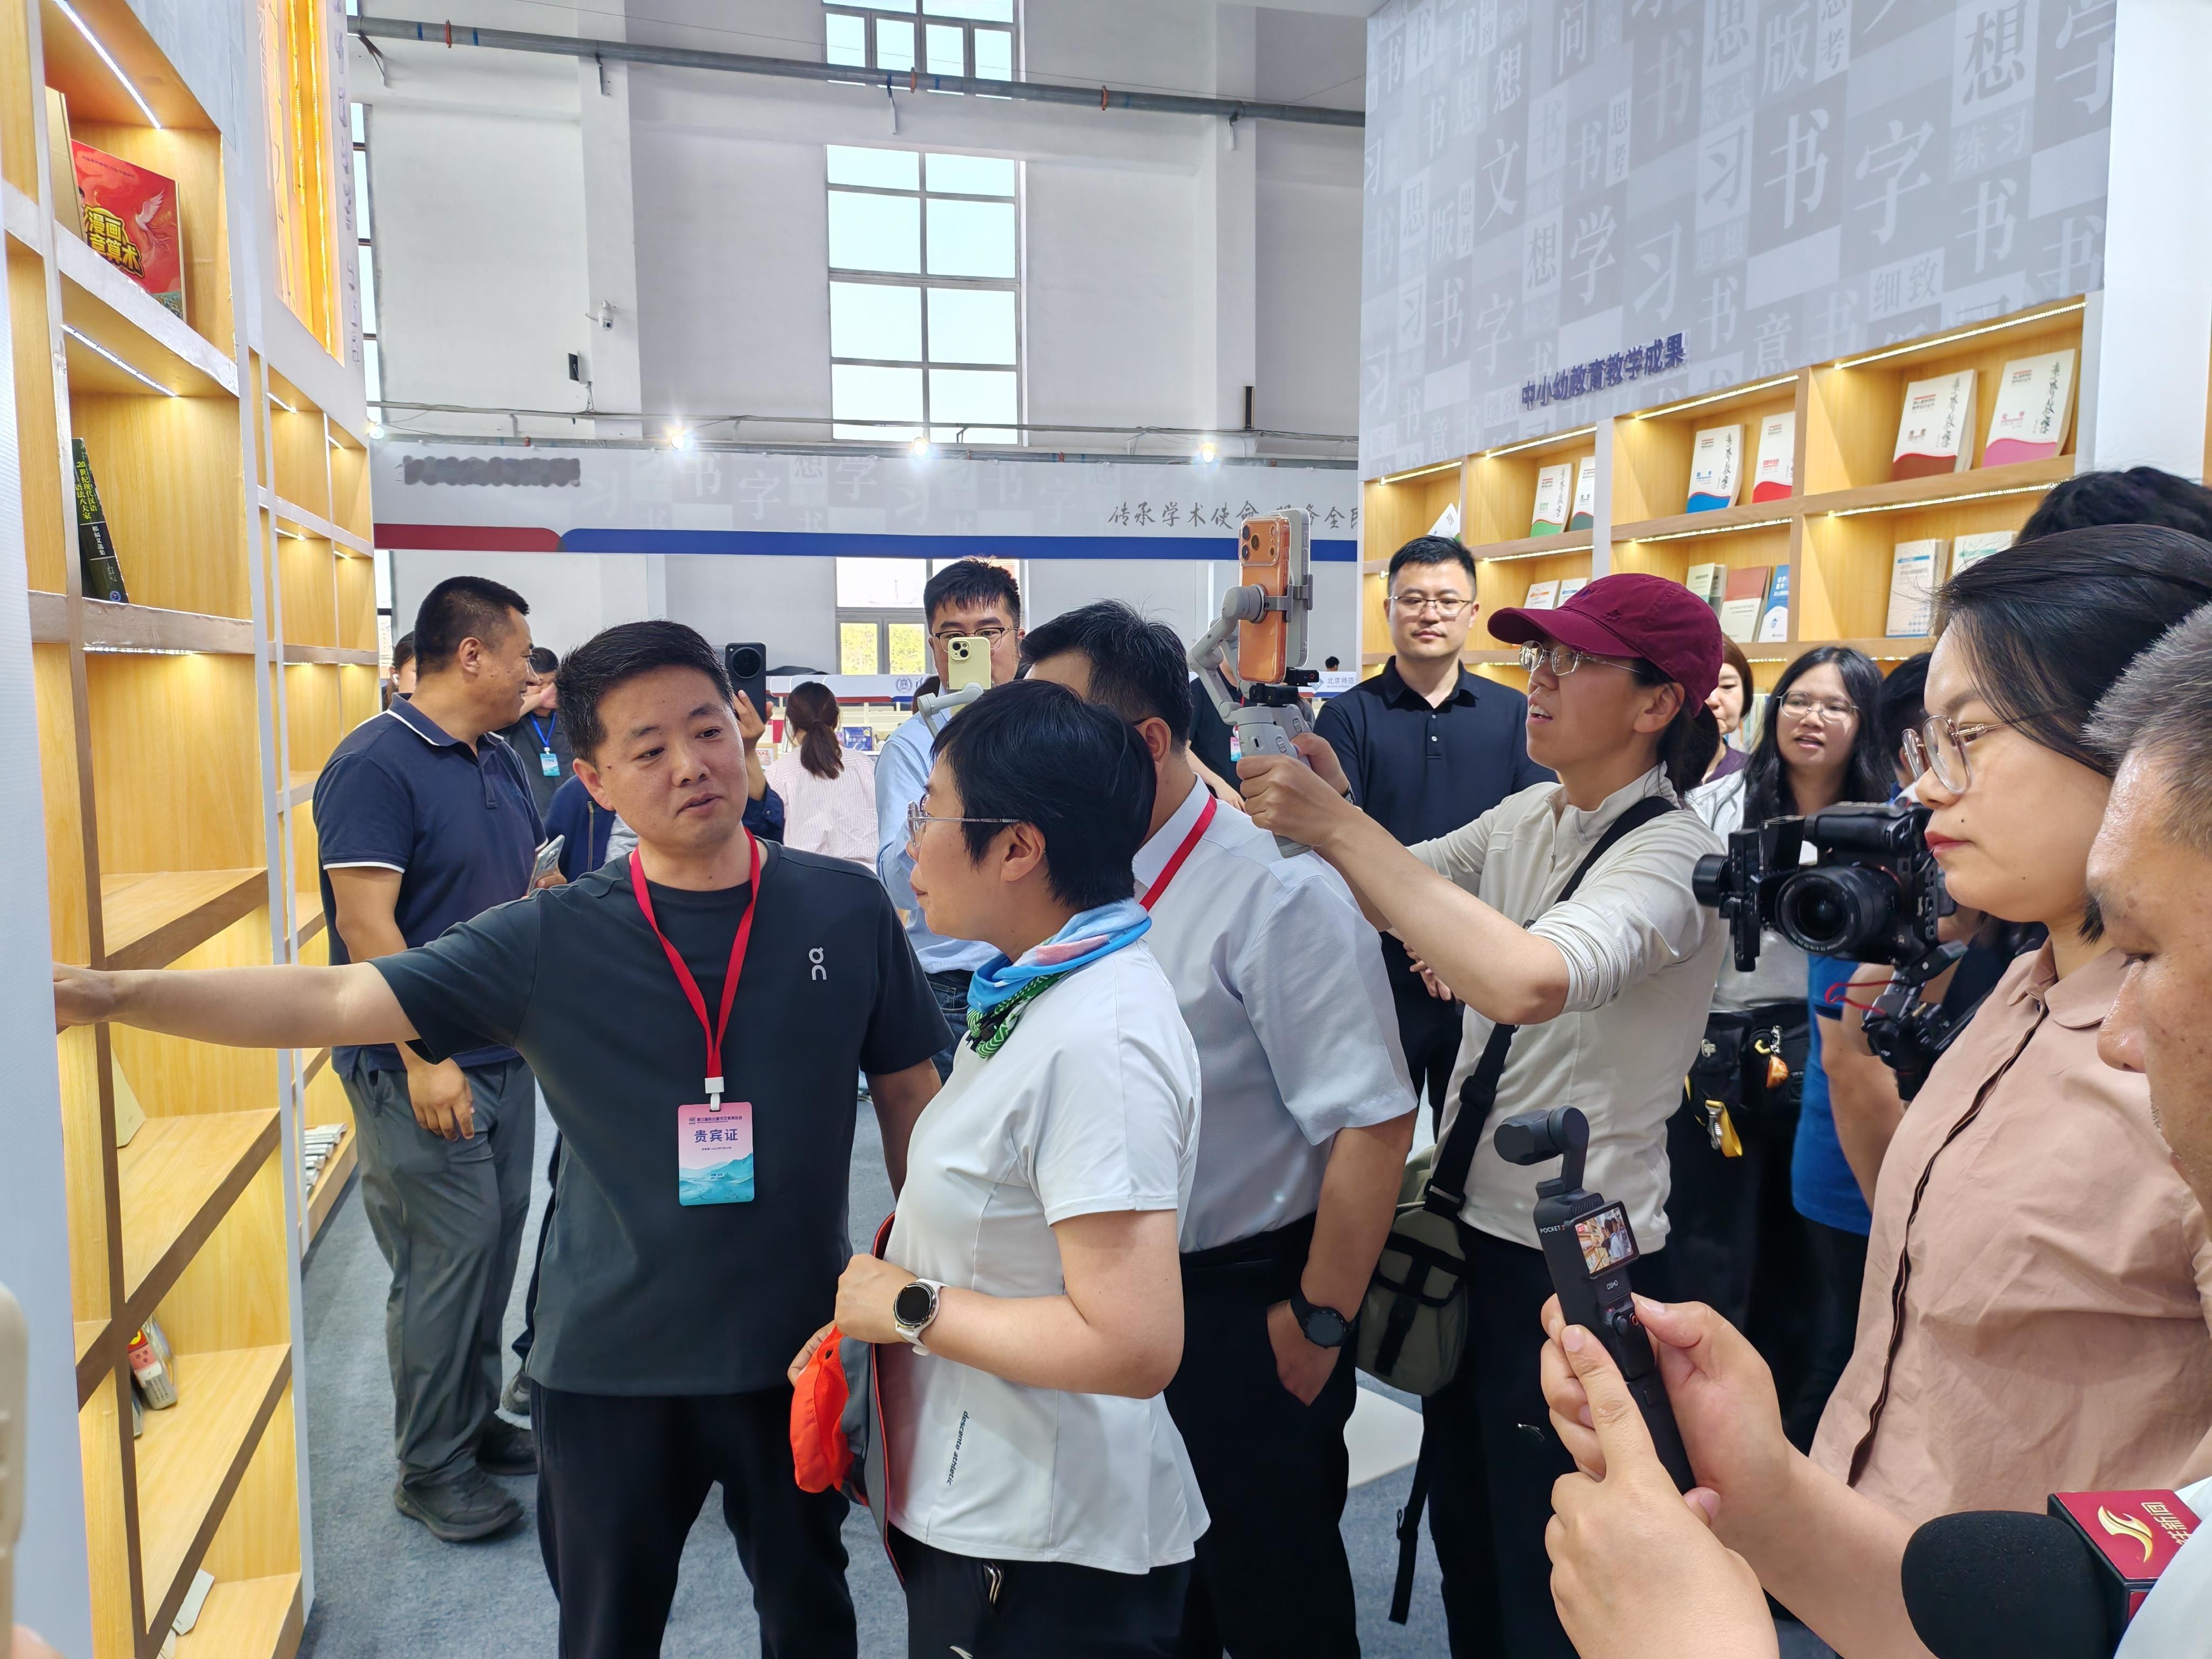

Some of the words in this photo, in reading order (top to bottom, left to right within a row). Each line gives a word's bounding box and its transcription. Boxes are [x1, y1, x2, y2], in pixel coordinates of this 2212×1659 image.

[1381, 36, 1402, 93] 书
[1557, 0, 1588, 77] 问
[1761, 1, 1811, 102] 版
[1963, 0, 2025, 105] 想
[1494, 42, 1522, 114] 想
[1640, 29, 1694, 143] 书
[1422, 95, 1446, 159] 书
[1570, 120, 1602, 190] 书
[1611, 100, 1627, 176] 思考
[1479, 139, 1519, 231] 文
[1703, 125, 1748, 210] 习
[1764, 109, 1829, 230] 书
[1854, 120, 1934, 245] 字
[86, 211, 122, 241] 漫画
[1404, 182, 1425, 237] 思
[1431, 200, 1455, 265] 版
[1460, 187, 1472, 252] 思考
[1955, 179, 2017, 273] 书
[1528, 221, 1557, 289] 想
[1570, 205, 1617, 306] 学
[1634, 221, 1682, 323] 习
[1873, 257, 1938, 312] 细致
[1402, 282, 1423, 342] 习
[1433, 277, 1464, 358] 书
[1475, 292, 1513, 377] 字
[1698, 276, 1738, 352] 书
[1752, 313, 1793, 376] 意
[1366, 345, 1390, 415] 习
[1521, 333, 1686, 410] 中小幼教育教学成果
[1401, 387, 1420, 439] 书
[1429, 416, 1448, 462] 意
[694, 1129, 738, 1143] 贵宾证
[1540, 1225, 1561, 1233] POCKET
[1606, 1279, 1618, 1290] OSMO
[955, 1411, 969, 1451] descente
[947, 1451, 959, 1486] athletic
